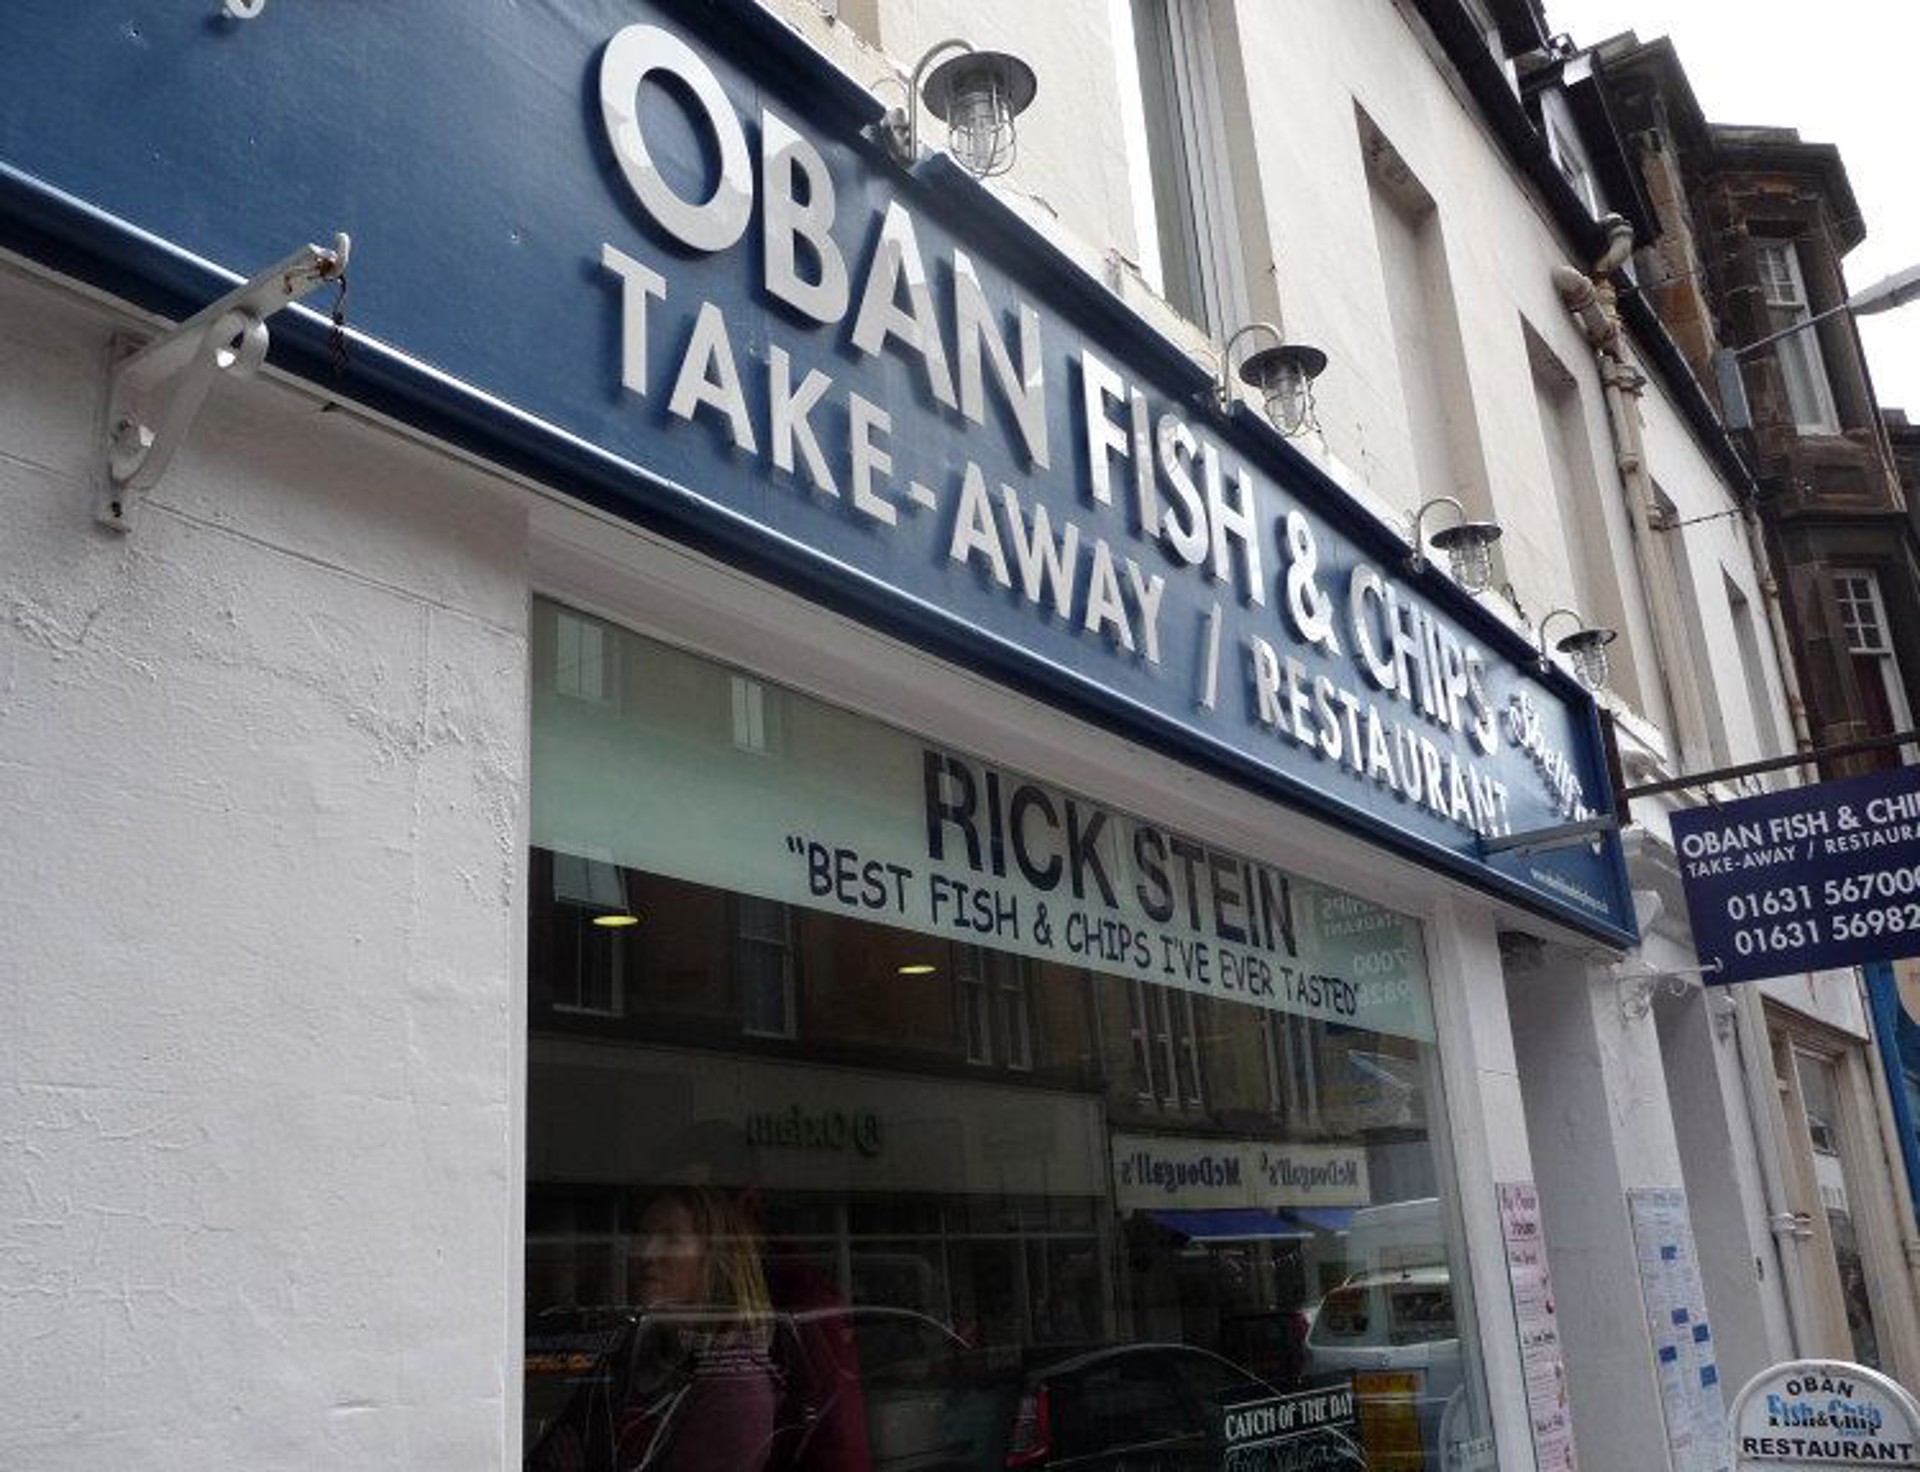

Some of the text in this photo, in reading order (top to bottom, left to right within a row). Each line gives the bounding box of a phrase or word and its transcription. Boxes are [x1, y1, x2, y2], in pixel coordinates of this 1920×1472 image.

[600, 23, 1498, 754] OBAN FISH & CHIPS
[602, 243, 1165, 665] TAKE-AWAY
[1251, 635, 1509, 838] RESTAURANT
[922, 750, 1298, 957] RICK STEIN
[1682, 822, 1763, 858] OBAN
[1769, 811, 1829, 844] FISH
[1837, 805, 1861, 831] &
[1687, 846, 1796, 879] TAKE-AWAY
[786, 836, 912, 913] "BEST
[931, 874, 1019, 940] FISH
[1034, 903, 1053, 946] &
[1067, 913, 1150, 970] CHIPS
[1159, 935, 1210, 986] I'VE
[1220, 952, 1275, 999] EVER
[1727, 885, 1812, 920] 01631
[1734, 920, 1821, 955] 01631
[1786, 1376, 1854, 1397] OBAN
[1225, 1406, 1275, 1442] CATCH
[1279, 1402, 1298, 1430] OF
[1300, 1396, 1327, 1425] THE
[1743, 1438, 1913, 1461] RESTAURANT
